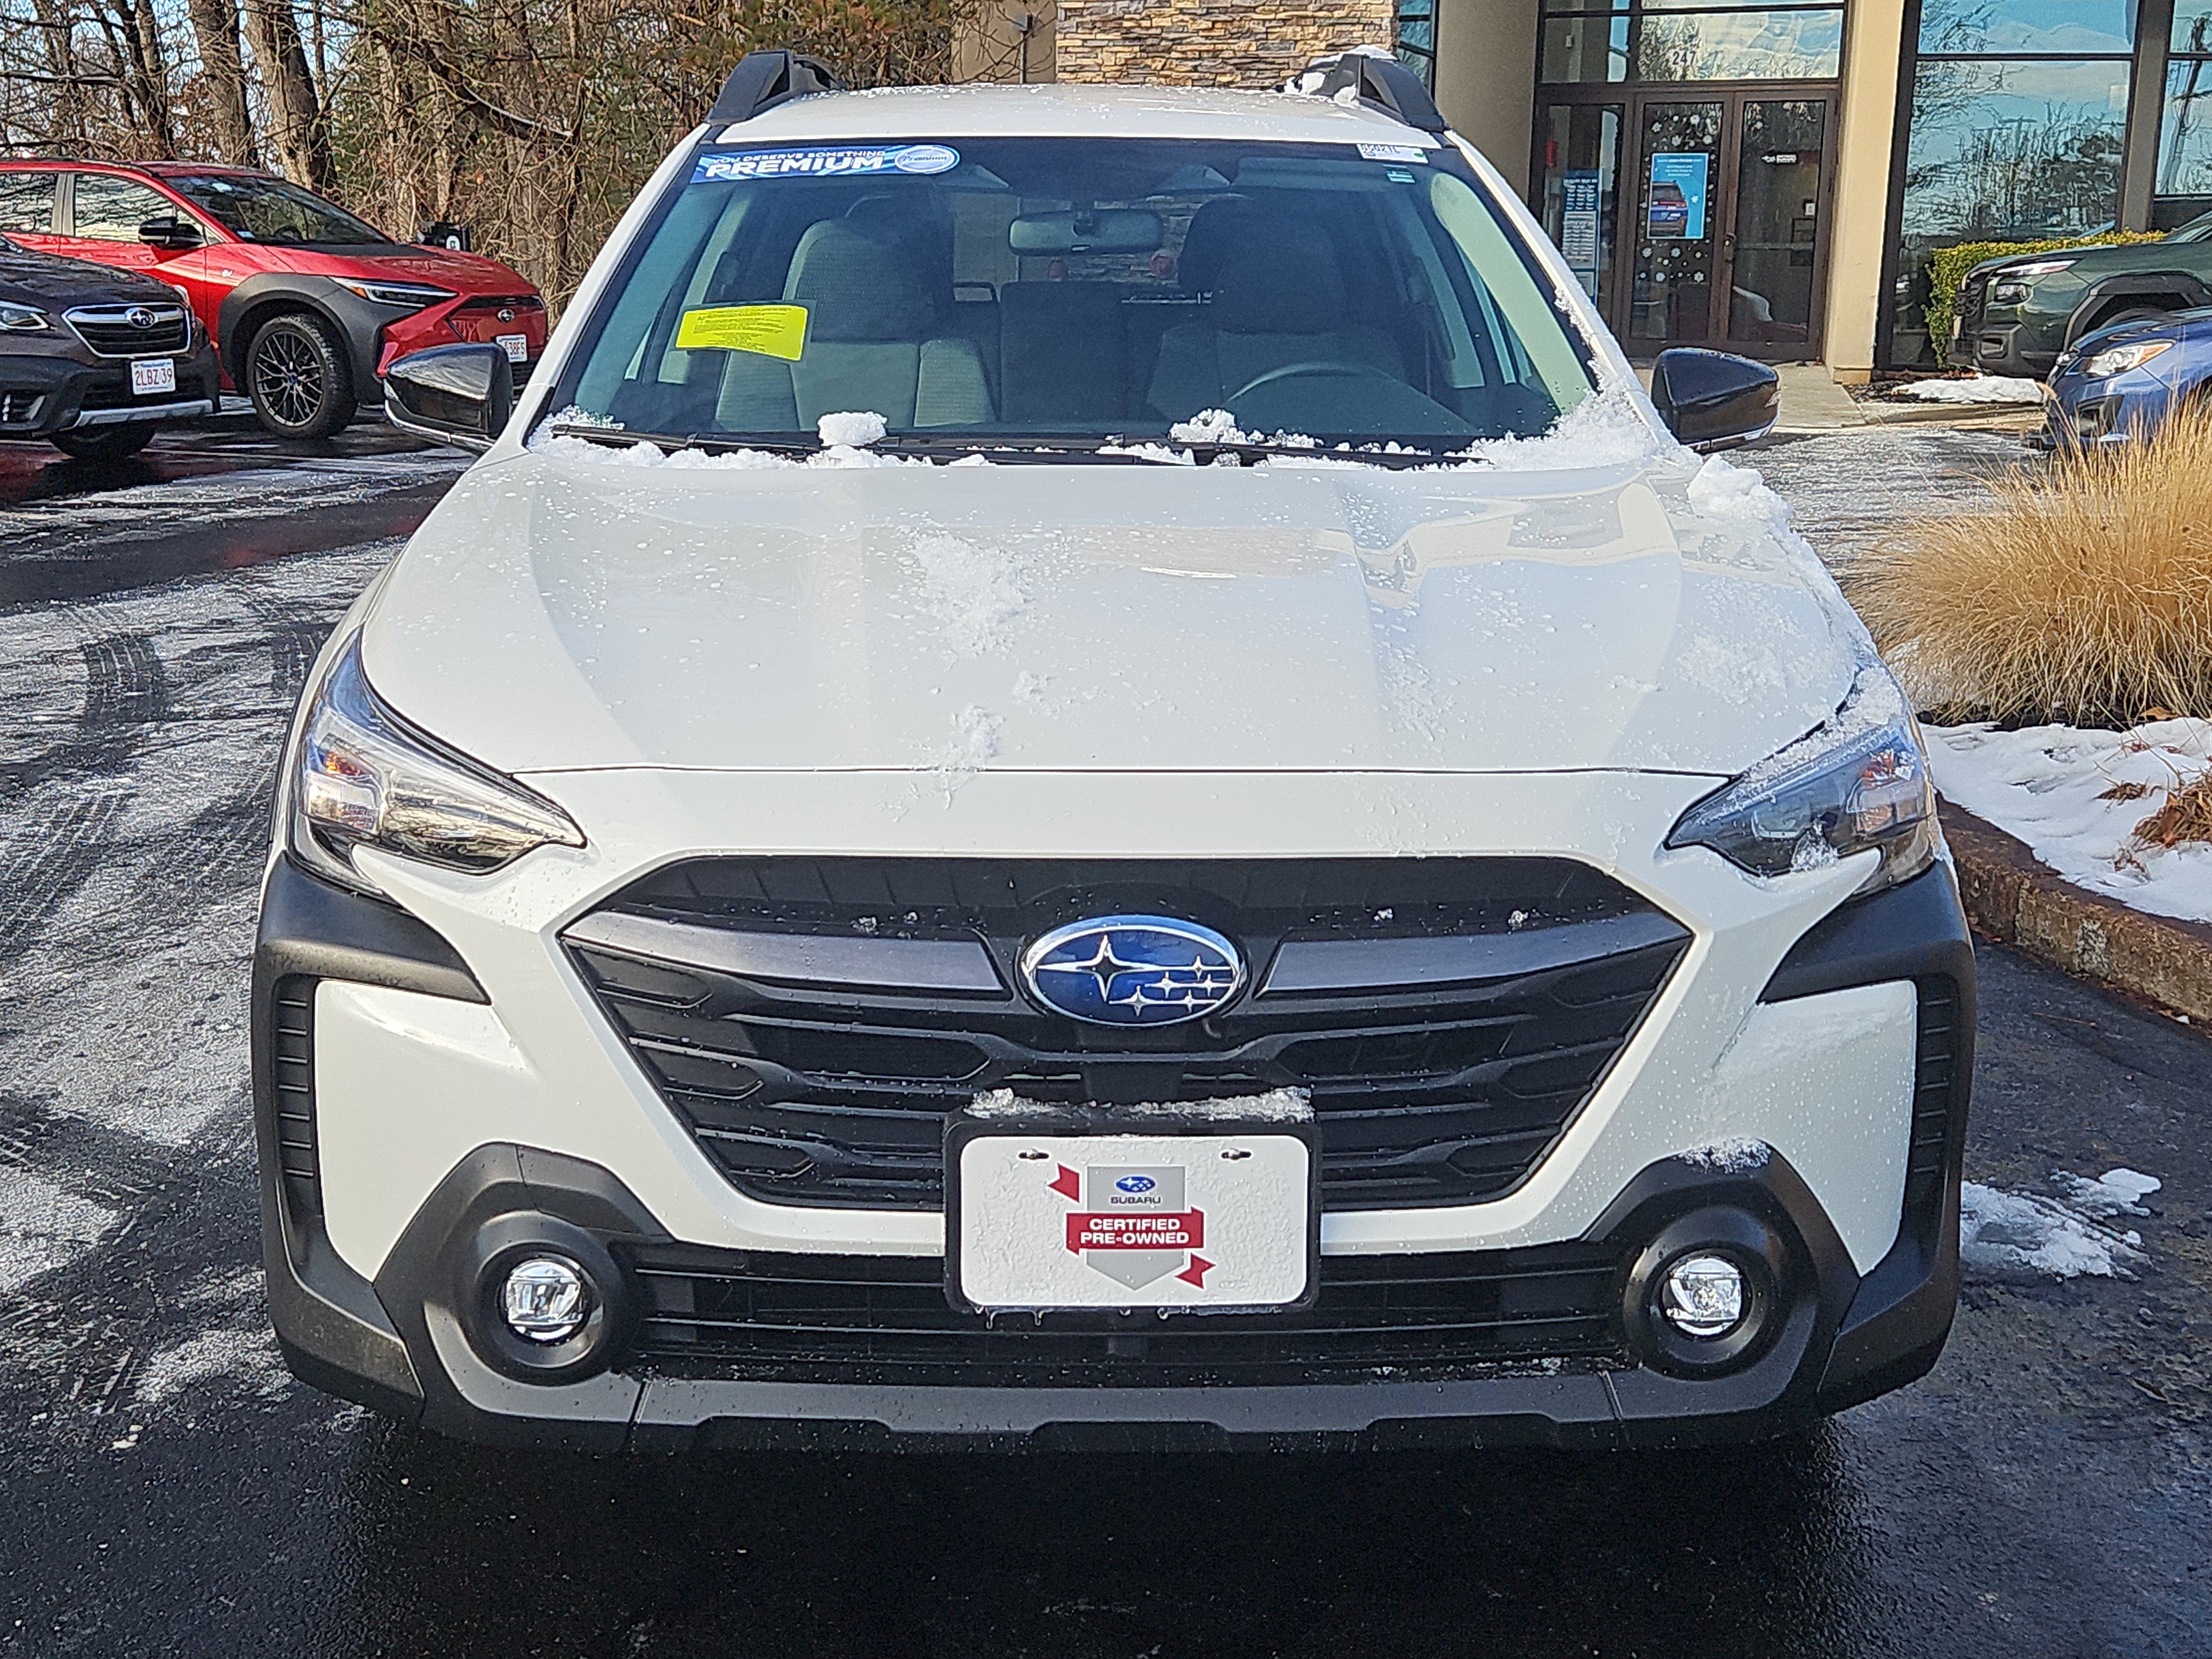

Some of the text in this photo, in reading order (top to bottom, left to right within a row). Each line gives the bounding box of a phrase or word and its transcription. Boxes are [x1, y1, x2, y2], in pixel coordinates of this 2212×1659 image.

[1672, 51, 1696, 65] 247
[743, 153, 804, 162] DESERVE
[706, 157, 884, 177] PREMIUM
[135, 368, 172, 387] 2LBZ 39
[1089, 1219, 1181, 1231] CERTIFIED
[1081, 1232, 1189, 1244] PRE-OWNED
